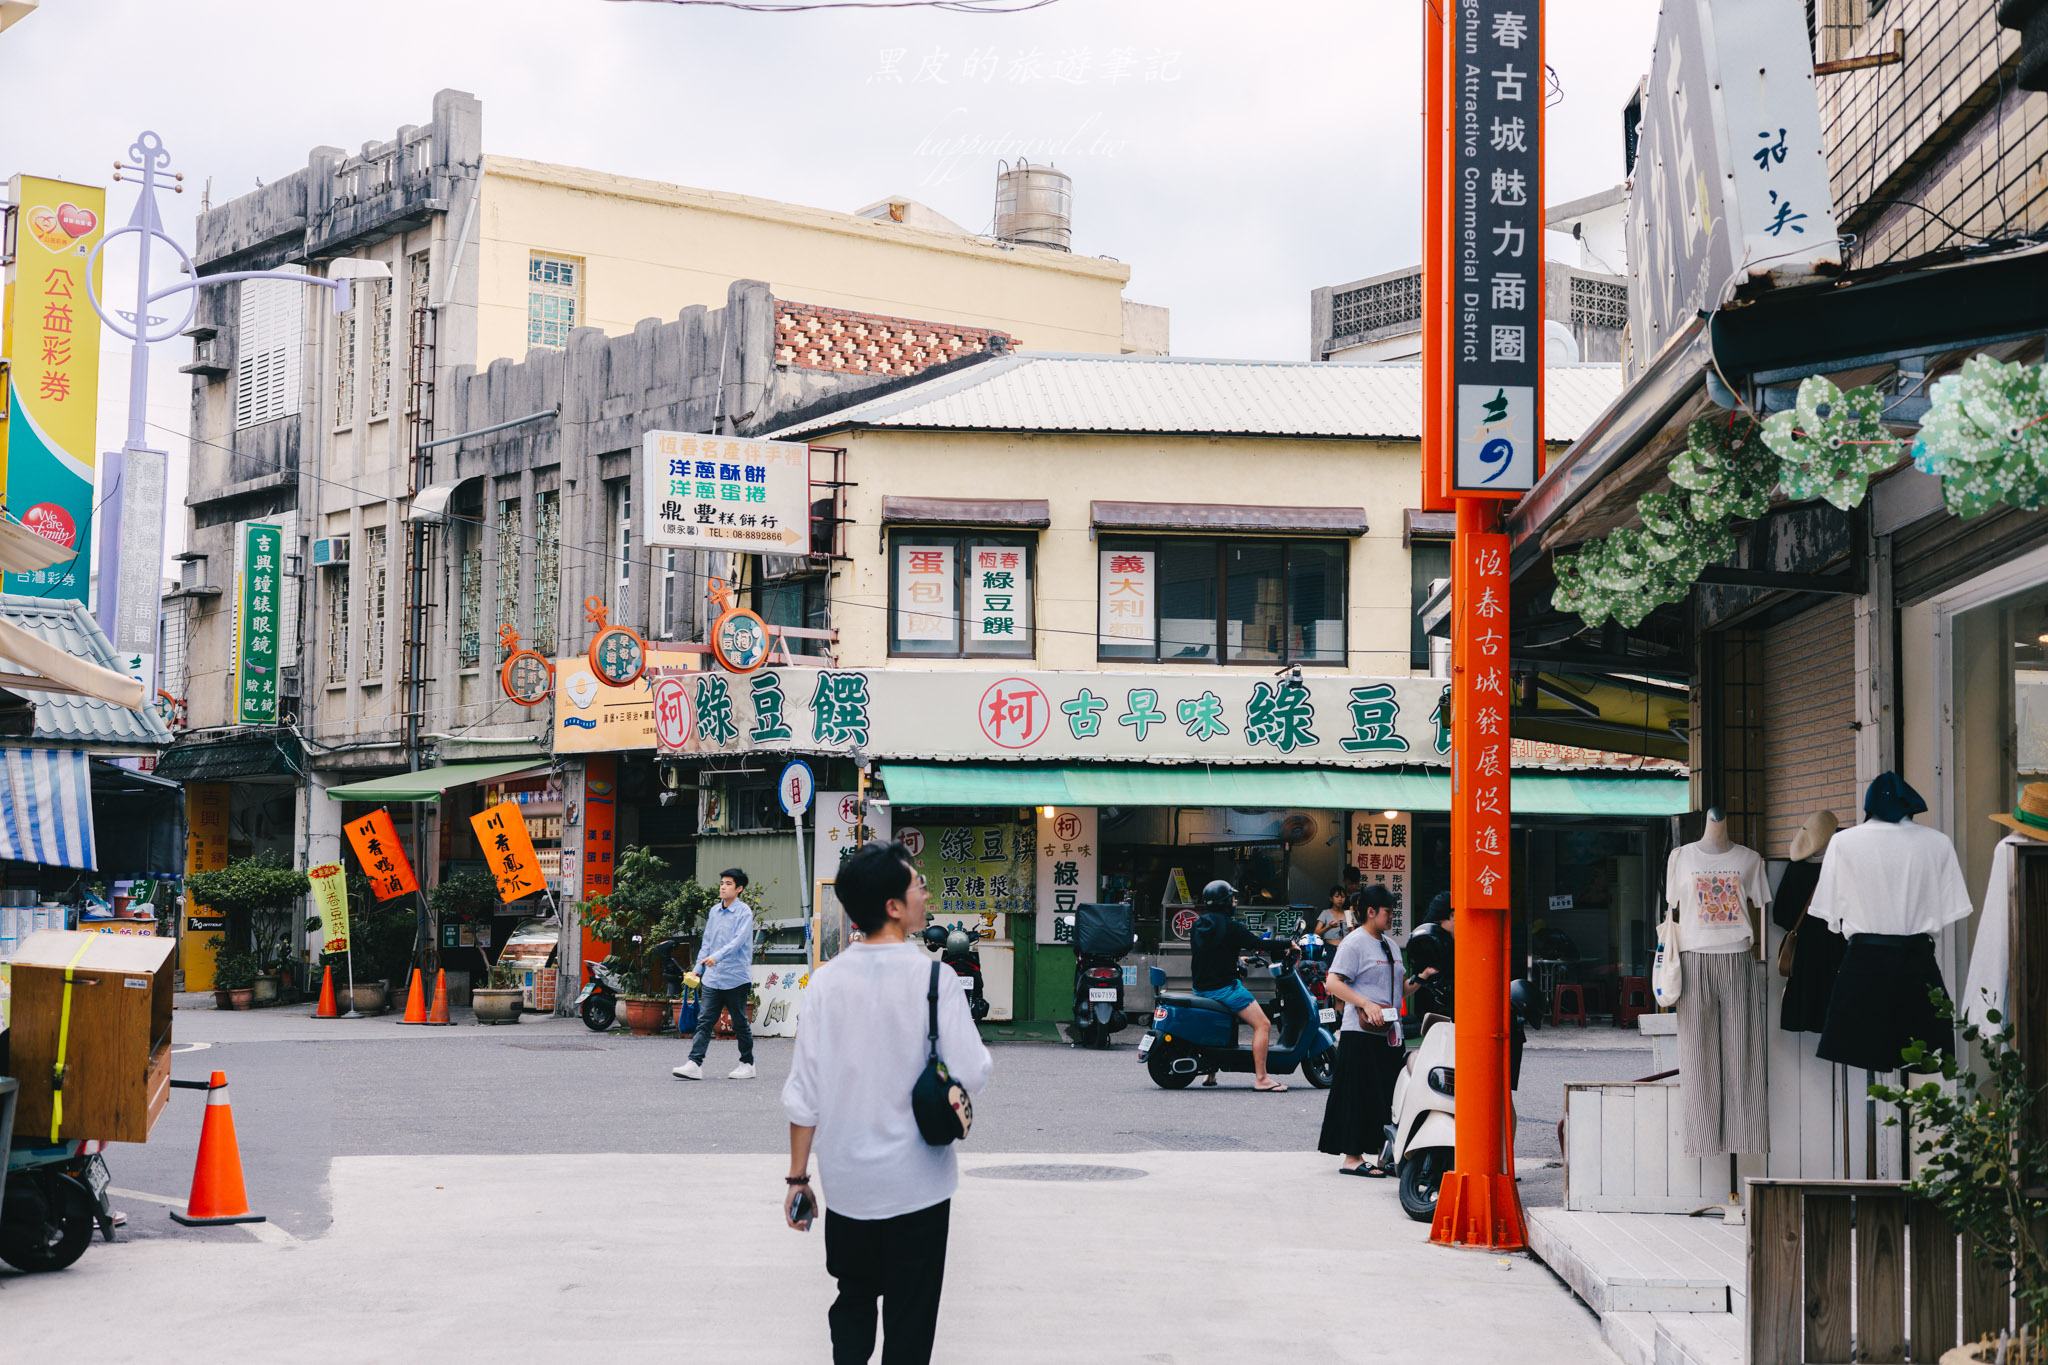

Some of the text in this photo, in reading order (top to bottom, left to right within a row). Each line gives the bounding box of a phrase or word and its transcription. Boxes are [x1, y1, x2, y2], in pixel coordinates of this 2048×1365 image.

[1464, 64, 1481, 158] Attractive
[1490, 11, 1528, 363] 春古城魅力商圈
[1464, 167, 1481, 283] Commercial
[40, 268, 75, 402] 公益彩券
[1463, 293, 1480, 363] District
[39, 510, 58, 521] We
[732, 530, 782, 542] 08-8892866
[251, 534, 275, 655] 吉興鐘錶眼鏡
[908, 551, 944, 635] 蛋包飯
[978, 551, 1019, 569] 恆春
[982, 571, 1015, 635] 綠豆饌
[1109, 555, 1147, 638] 義大利麵
[243, 697, 275, 713] 配鏡
[245, 679, 275, 695] 驗光
[658, 671, 870, 747] 柯 綠豆饌
[988, 688, 1040, 741] 柯
[1061, 687, 1231, 742] 古早味
[1474, 548, 1504, 897] 恆春古城發展促進會
[487, 812, 532, 894] 川香鳳爪
[1044, 843, 1092, 858] 古早味
[1058, 816, 1076, 837] 柯
[1357, 853, 1406, 871] 恆春必吃
